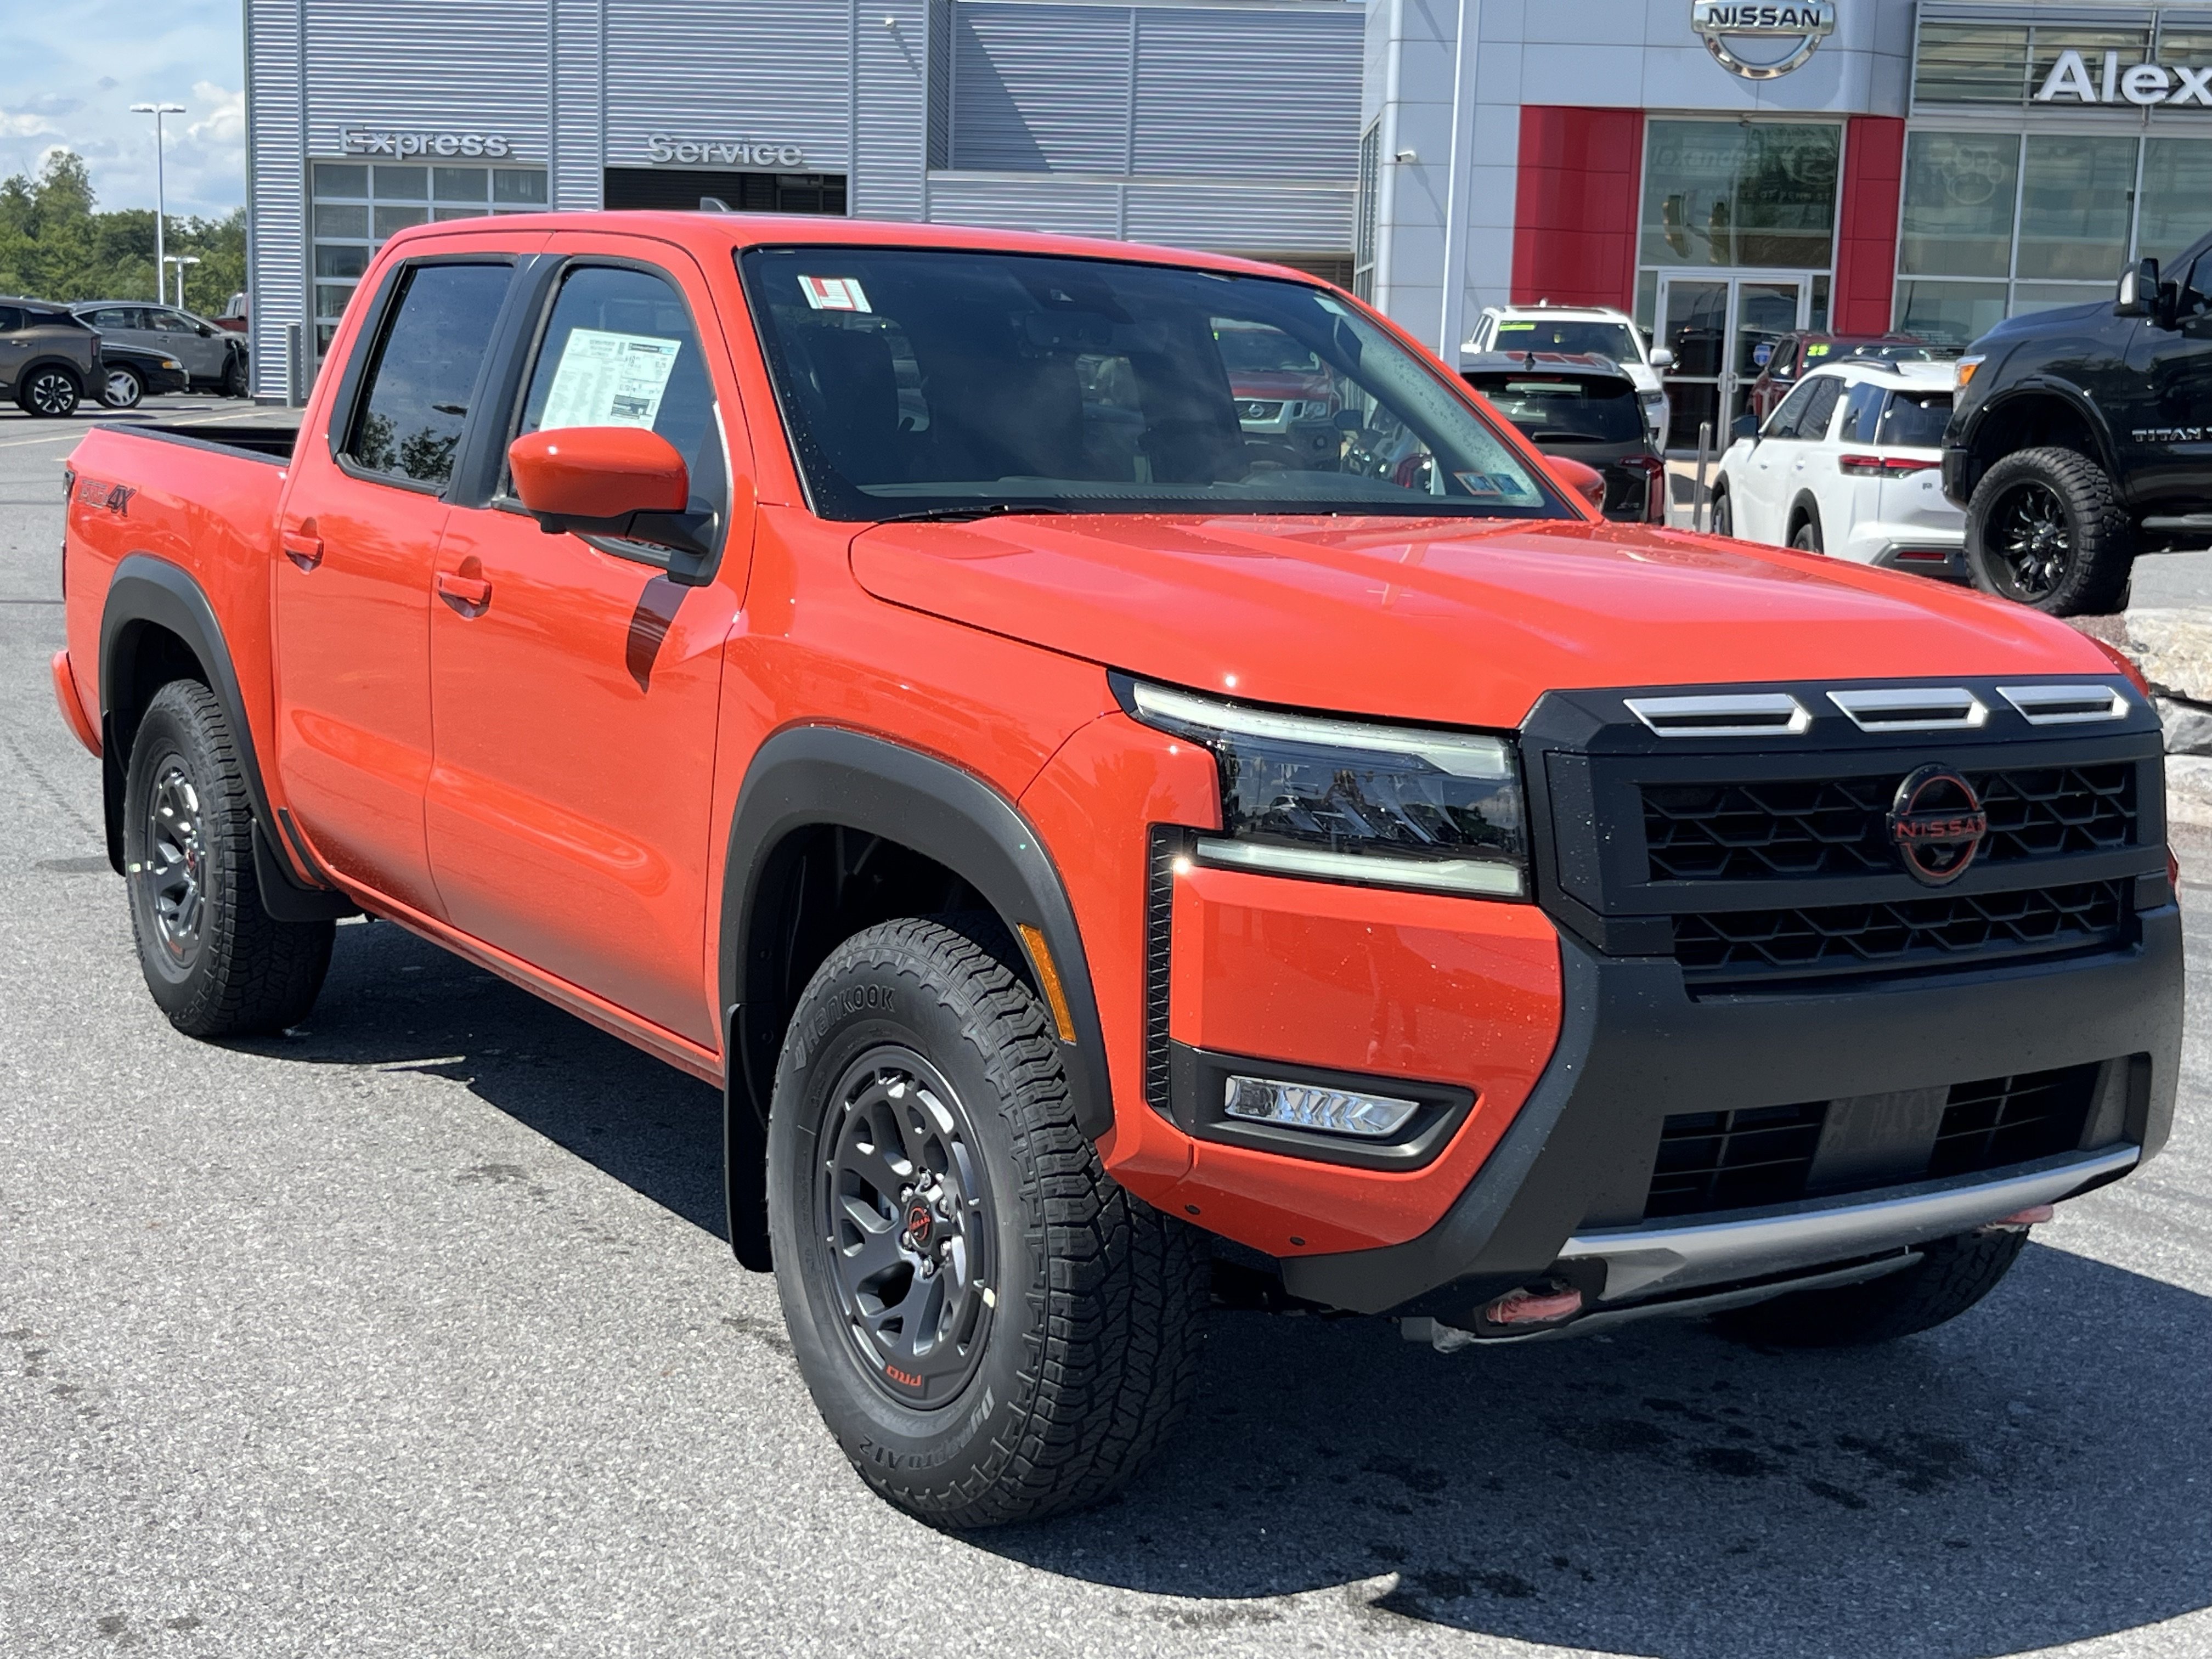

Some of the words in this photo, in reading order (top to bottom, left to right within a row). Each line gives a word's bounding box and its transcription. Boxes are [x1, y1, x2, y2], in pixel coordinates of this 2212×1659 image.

[1708, 6, 1820, 27] NISSAN
[339, 124, 509, 161] Express
[647, 133, 803, 166] Service
[2131, 427, 2202, 442] TITAN
[1896, 818, 1987, 839] NISSAN
[886, 1364, 922, 1387] PRO
